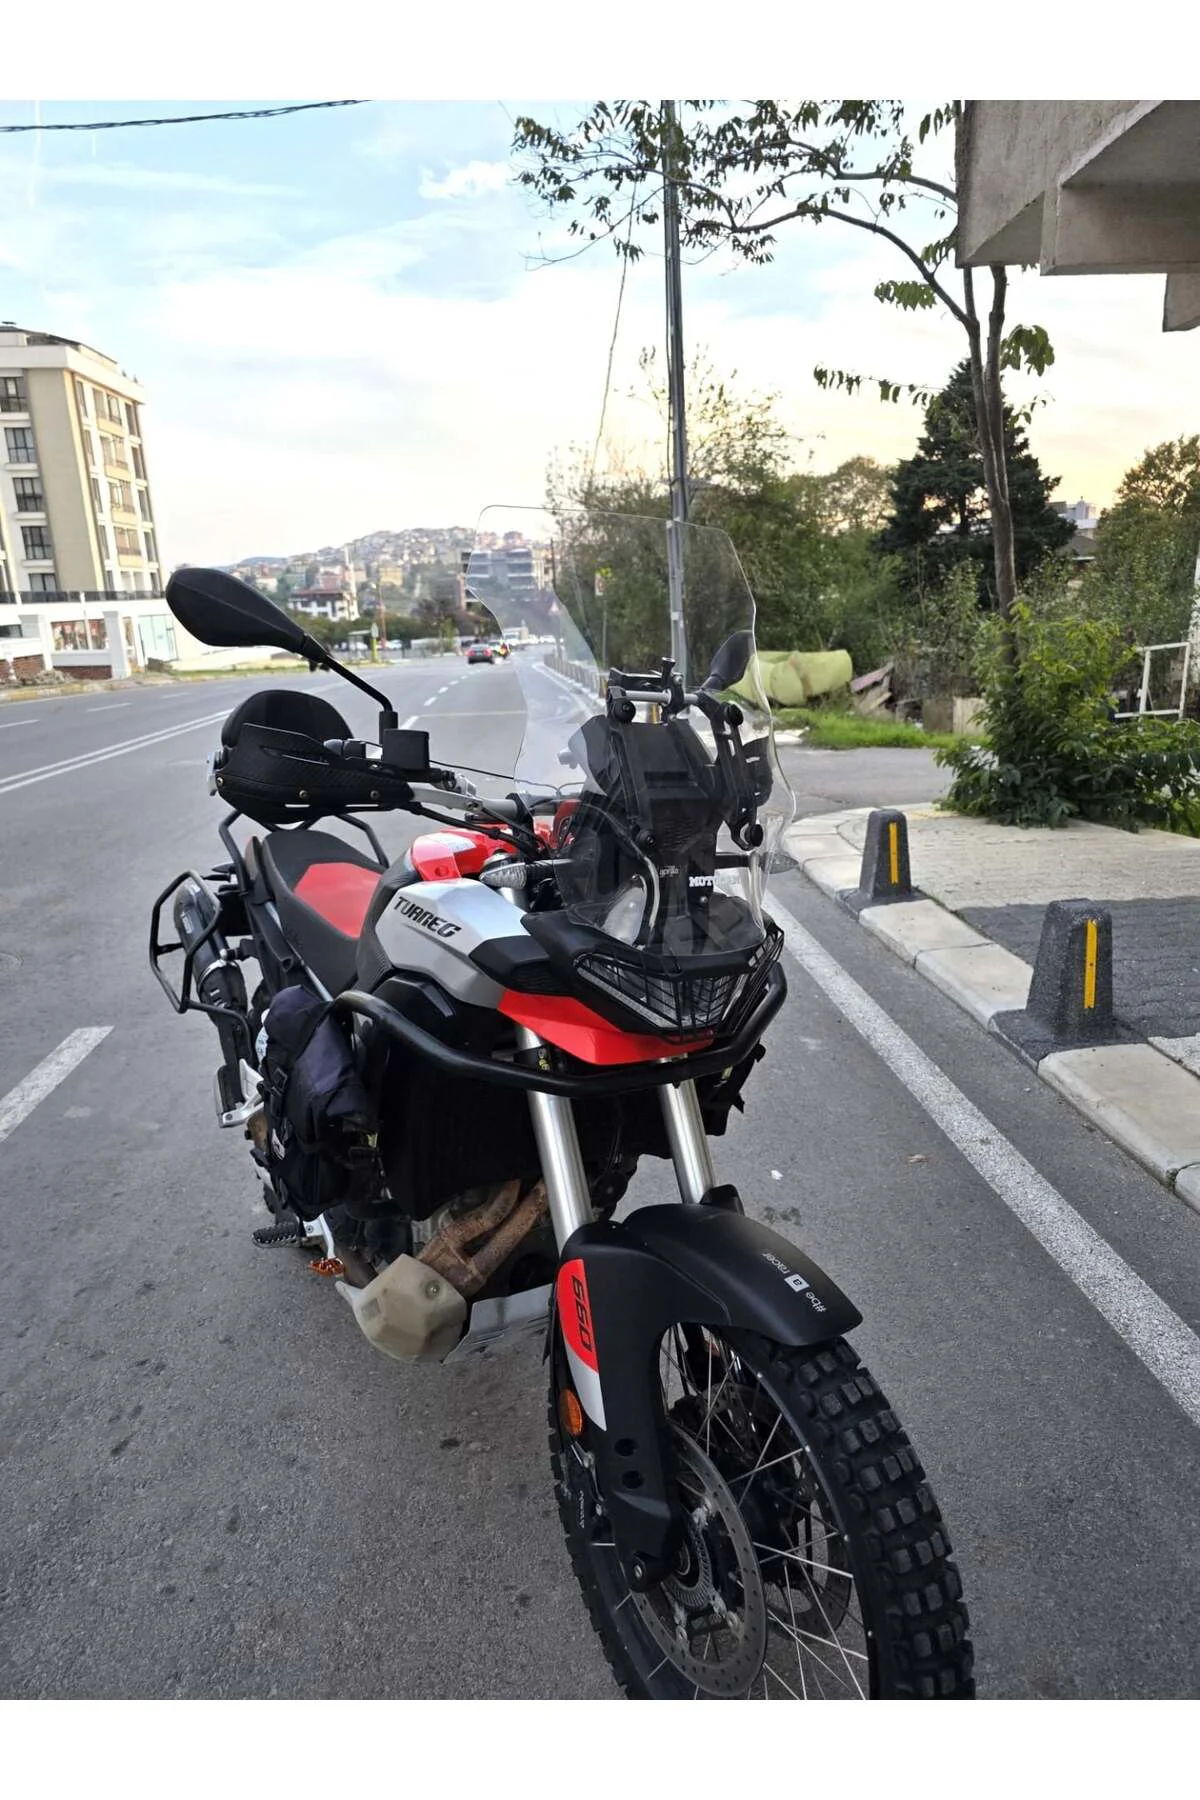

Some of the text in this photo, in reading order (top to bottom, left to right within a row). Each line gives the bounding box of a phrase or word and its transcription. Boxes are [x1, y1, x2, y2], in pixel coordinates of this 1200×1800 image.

[394, 896, 462, 938] TUAREG
[761, 1252, 791, 1274] racer
[571, 1275, 593, 1352] 660
[805, 1291, 827, 1312] #be
